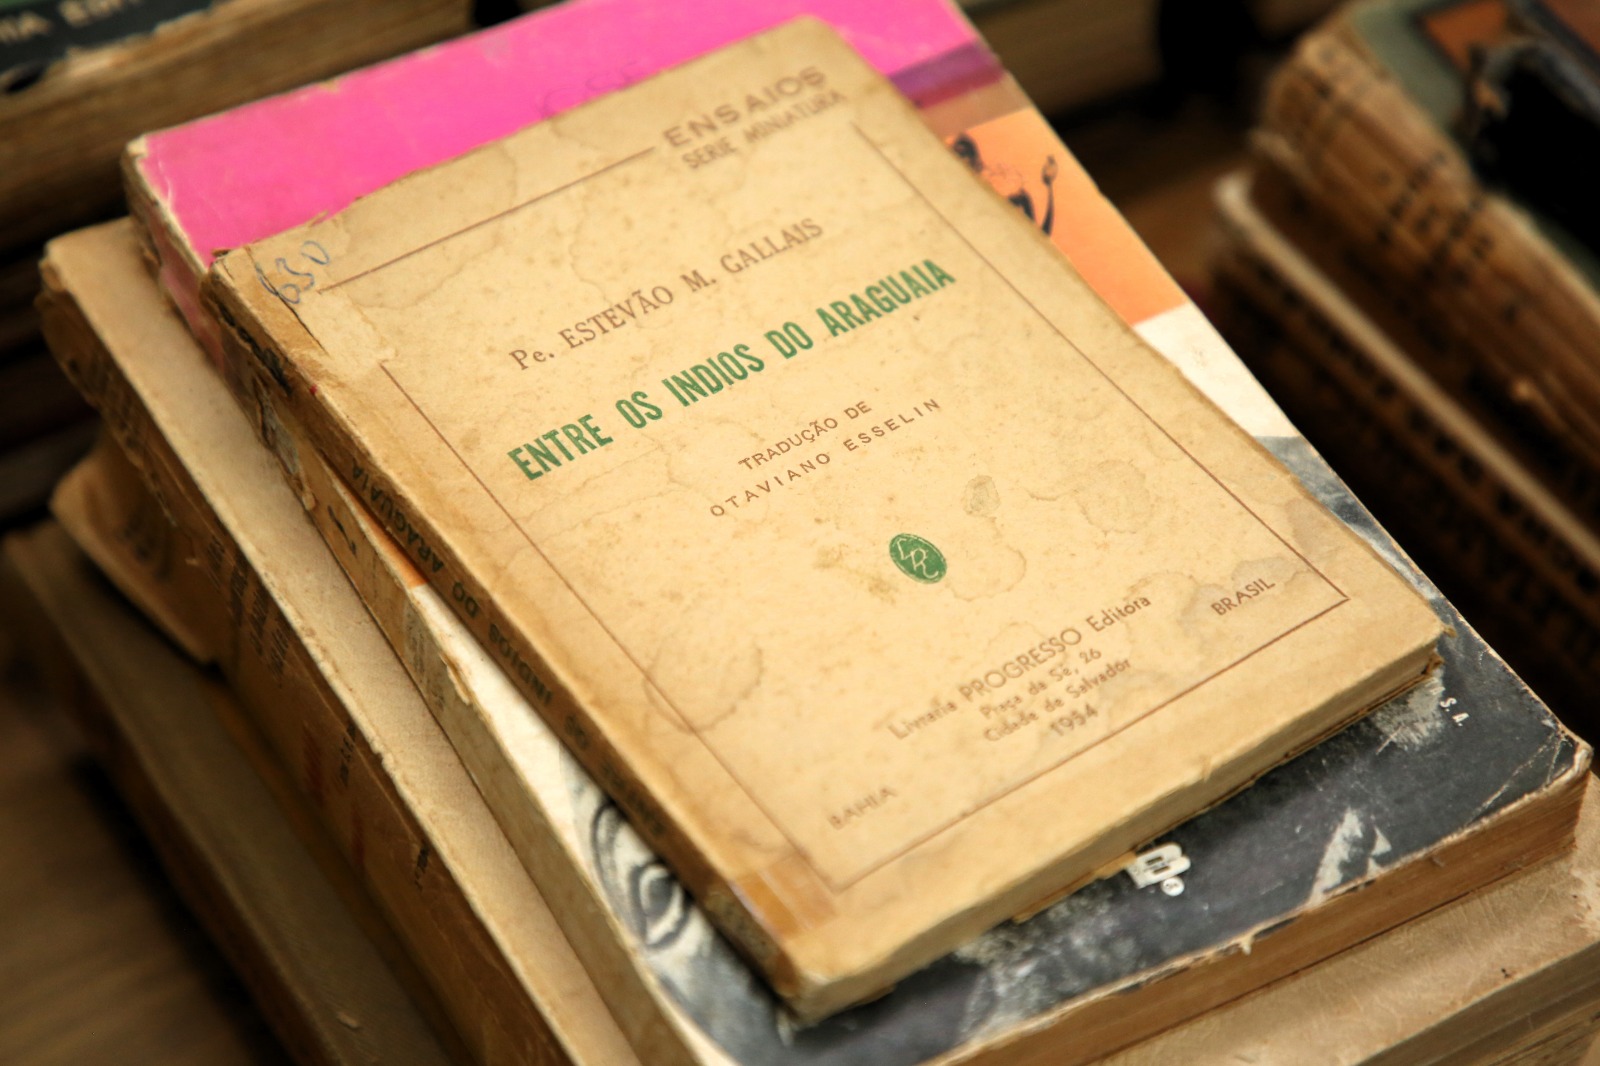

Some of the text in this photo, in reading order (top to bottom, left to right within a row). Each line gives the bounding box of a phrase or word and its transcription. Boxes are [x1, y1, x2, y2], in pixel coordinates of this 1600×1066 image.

[663, 66, 826, 147] ENSAIOS
[743, 89, 848, 143] MINIATURA
[509, 217, 824, 370] Pe. ESTEVÃO M. GALLAIS
[507, 258, 956, 481] ENTRE OS INDIOS DO ARAGUAIA
[710, 398, 941, 517] OTAVIANO ESSELIN
[738, 400, 872, 471] TRADUÇÃO DE
[351, 457, 445, 573] ARAGUAIA
[452, 582, 480, 618] DO
[1210, 578, 1276, 615] BRASIL
[888, 597, 1151, 740] Livraria PROGRESSO Editora
[980, 695, 1023, 719] Praça
[1028, 680, 1048, 696] da
[1079, 648, 1102, 665] 26
[983, 660, 1131, 741] Cidade de Salvador
[828, 787, 896, 831] BAHIA
